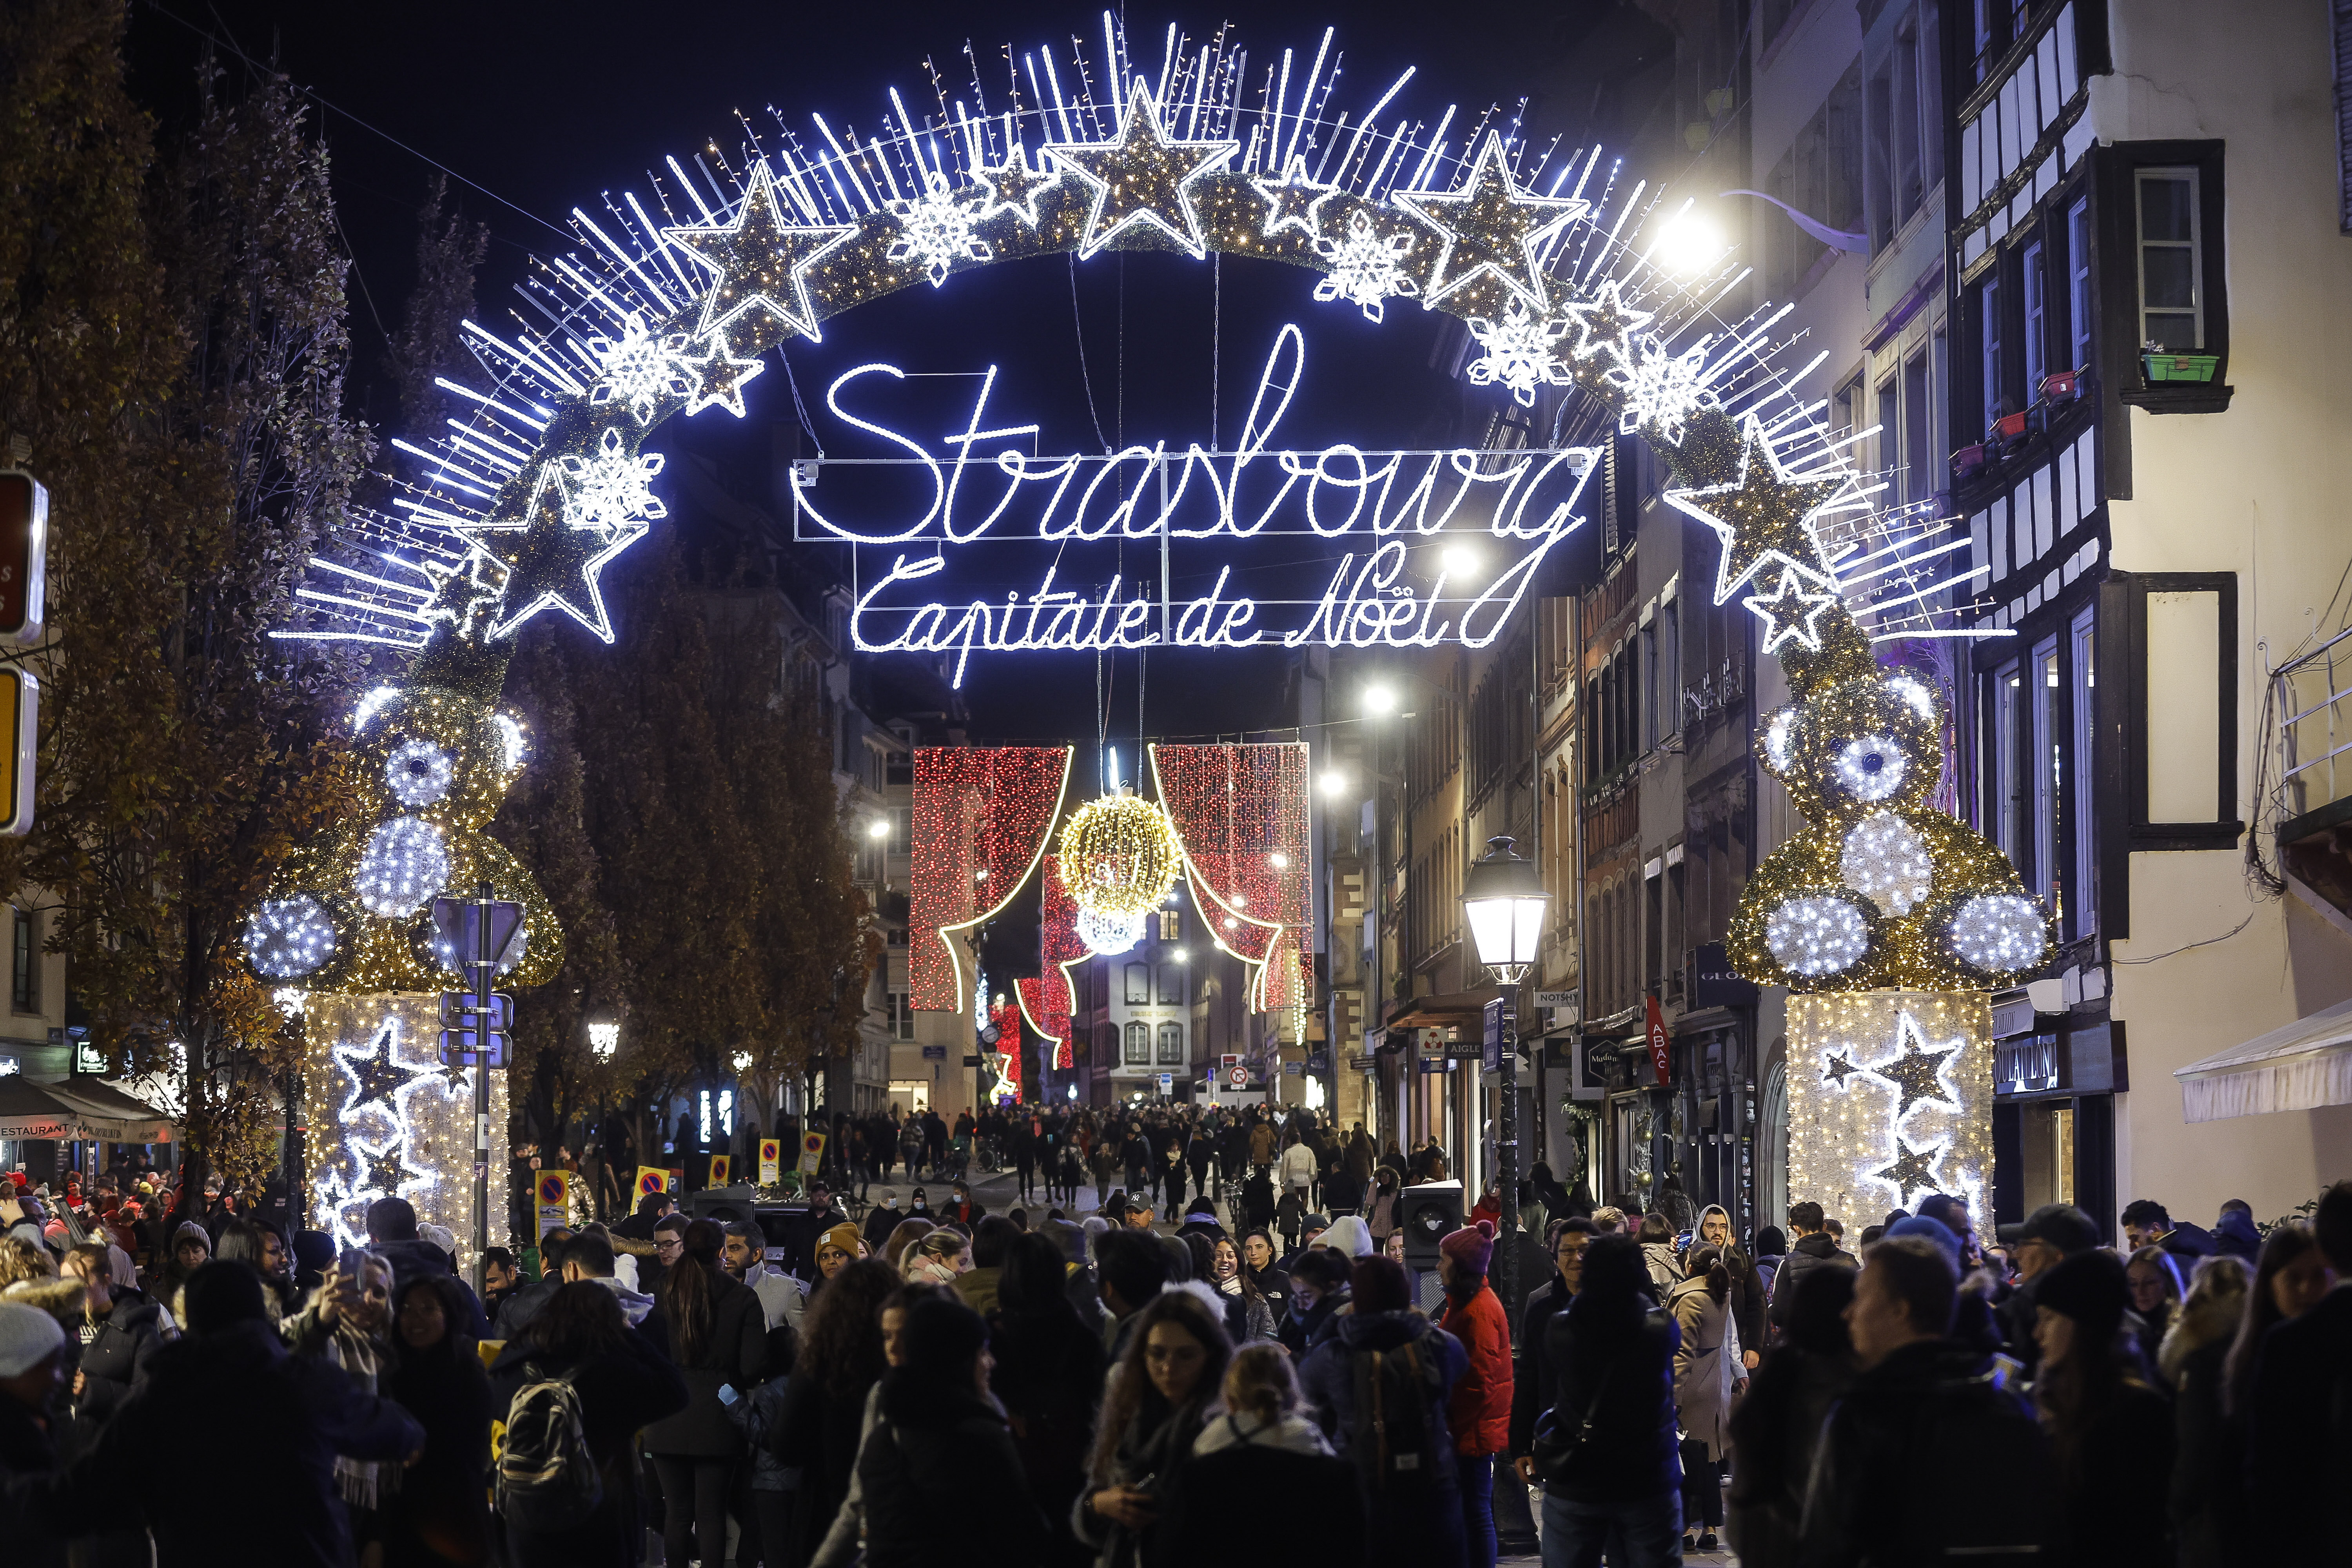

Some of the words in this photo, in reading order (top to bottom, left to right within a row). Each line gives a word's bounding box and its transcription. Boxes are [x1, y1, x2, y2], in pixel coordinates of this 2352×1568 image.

[789, 322, 1605, 649] Strasbourg
[851, 554, 1161, 690] Capitale
[1176, 565, 1263, 648] de
[1284, 540, 1450, 648] Noël
[1701, 971, 1744, 980] GEO
[1541, 993, 1578, 1002] NOTSHY
[1653, 1024, 1666, 1069] ABAC
[1592, 1053, 1619, 1062] Madam
[1994, 1042, 2051, 1083] OULAILLON
[0, 1123, 69, 1136] ESTAURANT
[668, 1178, 677, 1189] P
